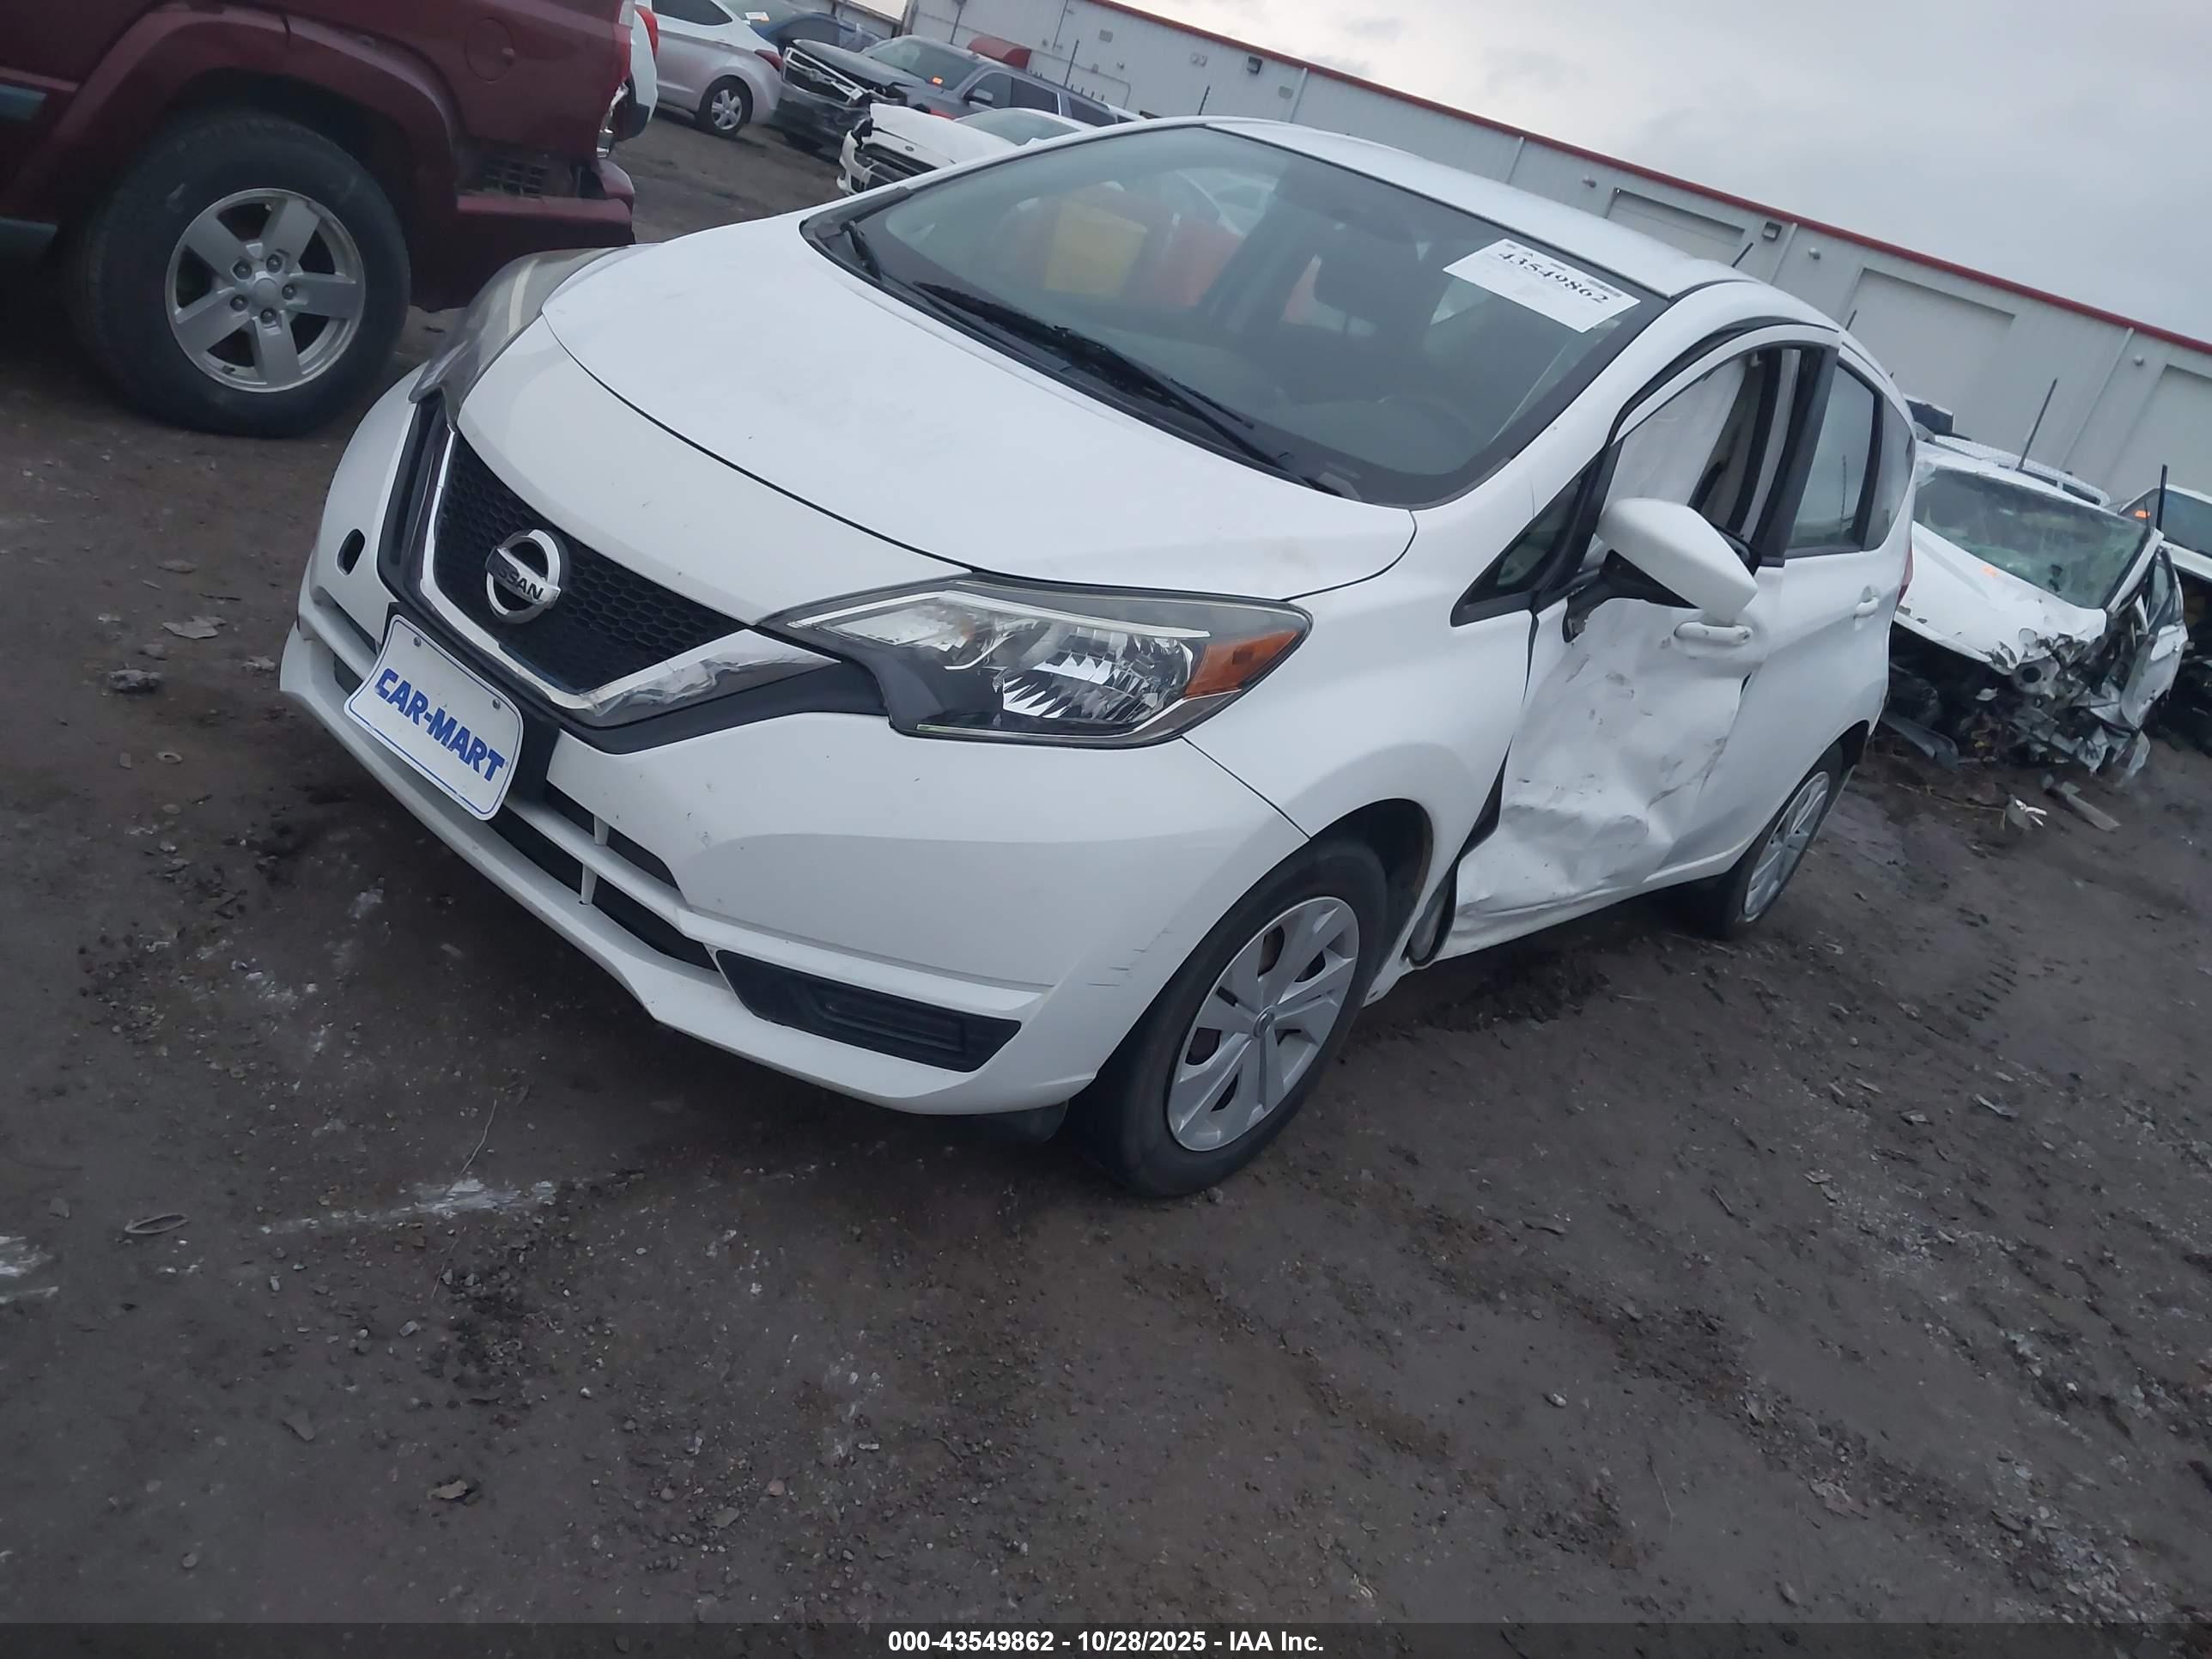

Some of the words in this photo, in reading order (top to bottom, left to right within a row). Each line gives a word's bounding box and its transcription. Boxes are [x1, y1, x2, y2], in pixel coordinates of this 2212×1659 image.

[1498, 252, 1609, 304] 43549862
[488, 551, 544, 600] SSAN
[374, 668, 505, 781] CAR-MART
